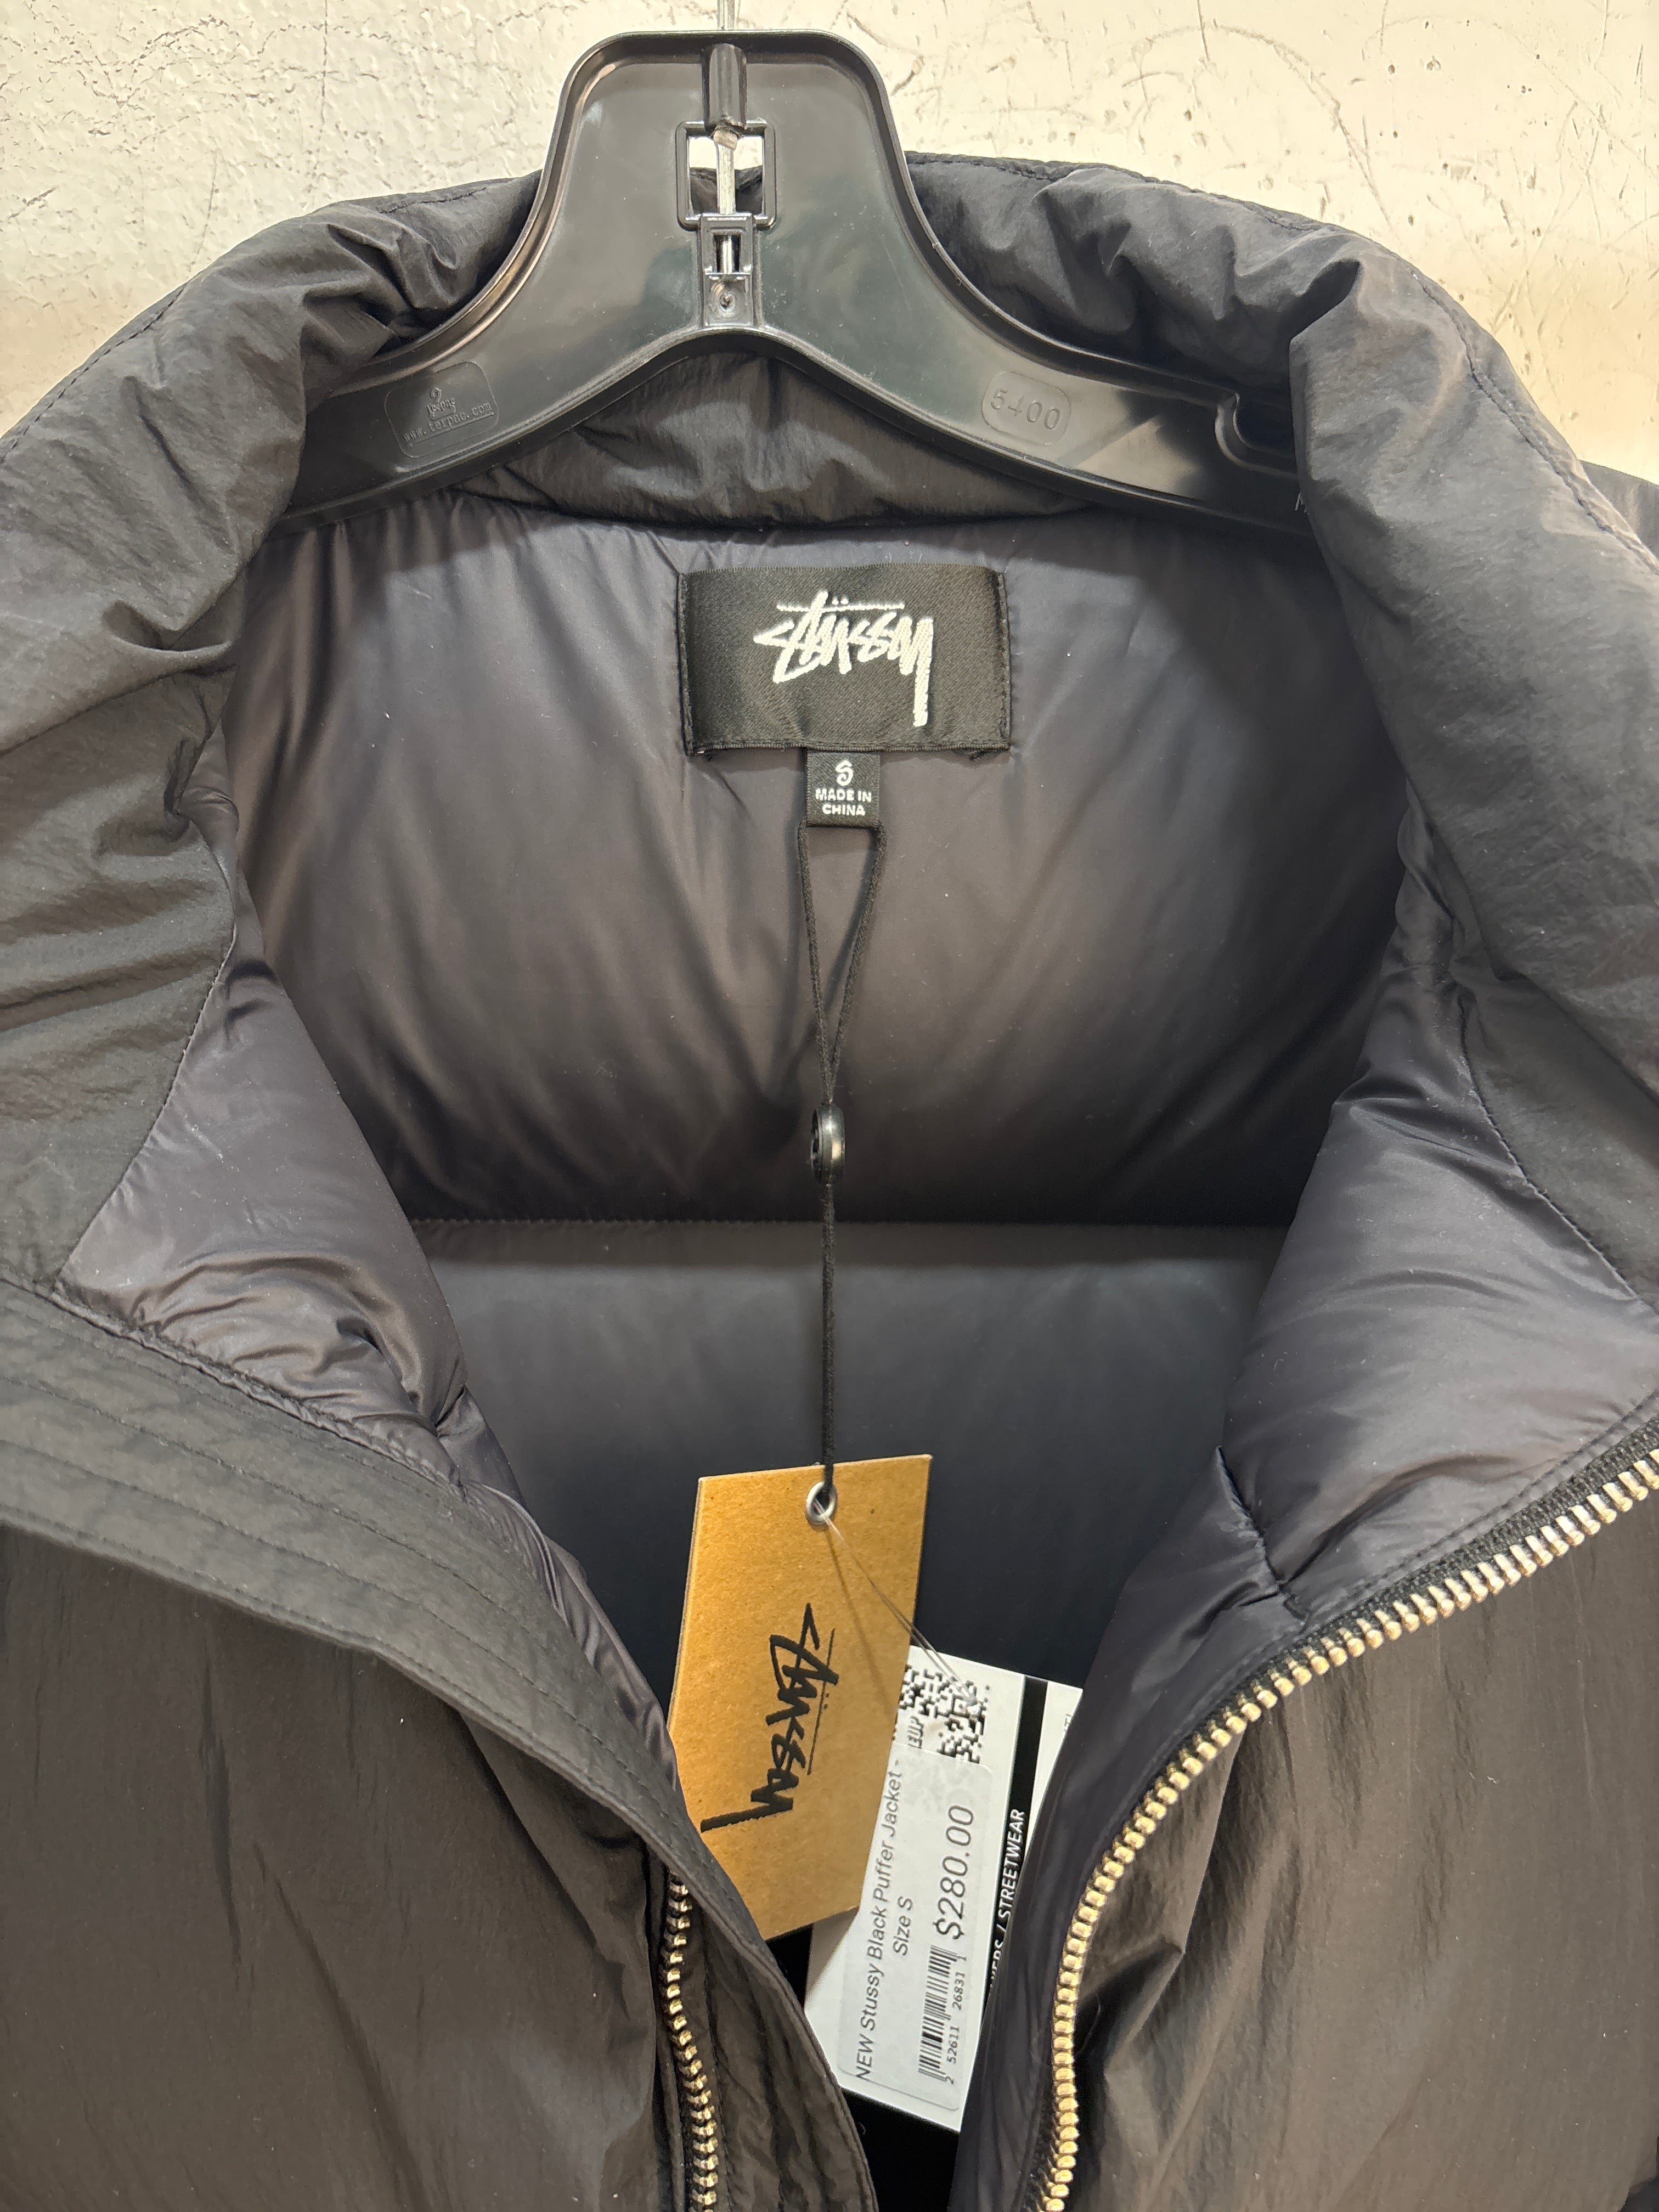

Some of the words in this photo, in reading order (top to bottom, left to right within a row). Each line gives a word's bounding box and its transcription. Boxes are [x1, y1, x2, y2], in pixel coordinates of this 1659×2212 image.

[835, 760, 854, 786] S
[815, 788, 855, 801] MADE
[857, 790, 872, 802] IN
[822, 804, 866, 816] CHINA
[881, 1770, 902, 1838] Jacket
[873, 1839, 894, 1903] Puffer
[933, 1805, 974, 1940] $280.00
[998, 1808, 1025, 1921] STREETWEAR
[897, 1895, 913, 1911] S
[866, 1906, 887, 1960] Black
[893, 1915, 911, 1956] Size
[860, 1963, 885, 2031] Stussy
[952, 1972, 966, 2011] 26831
[856, 2033, 874, 2080] NEW
[946, 2025, 960, 2064] 52611
[945, 2076, 955, 2085] 2
